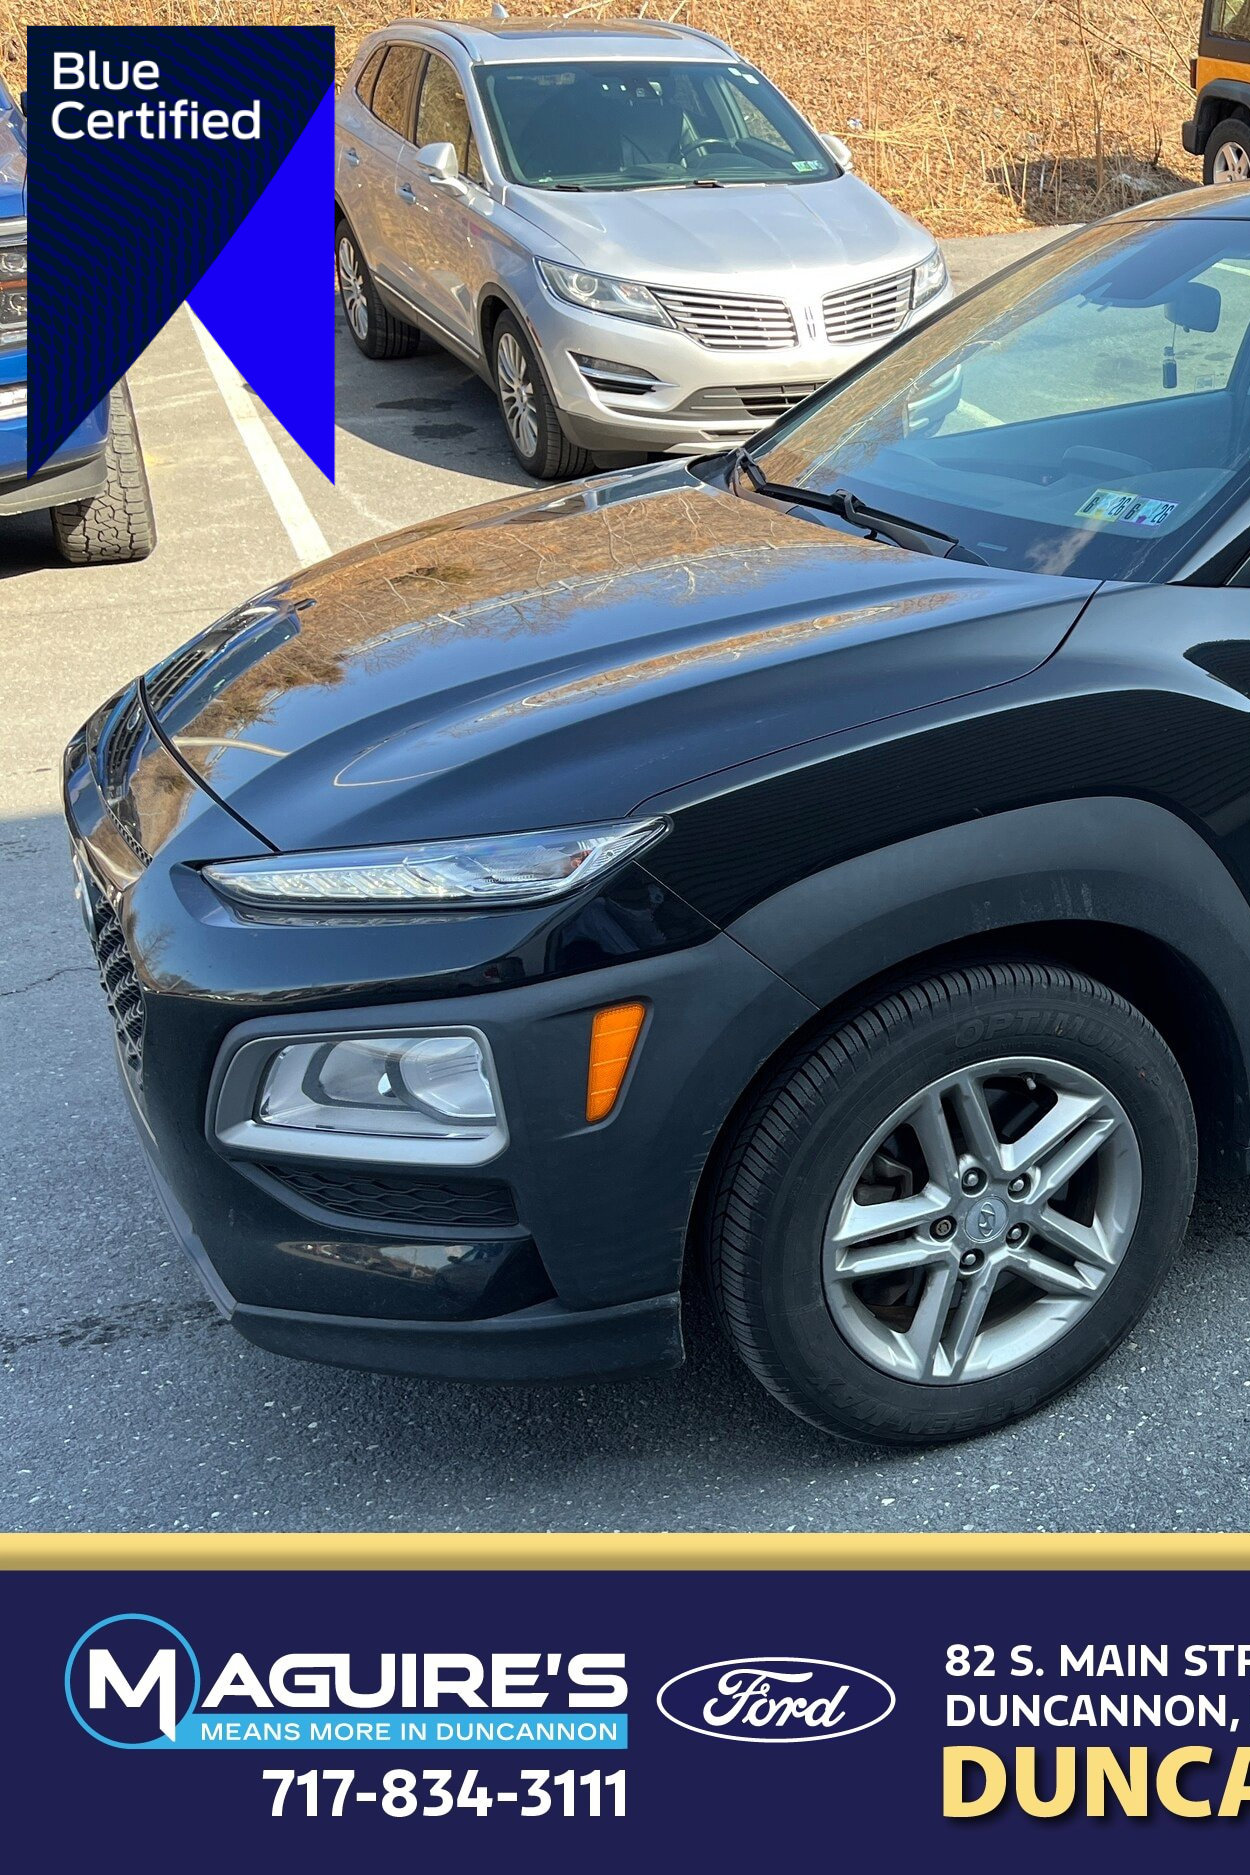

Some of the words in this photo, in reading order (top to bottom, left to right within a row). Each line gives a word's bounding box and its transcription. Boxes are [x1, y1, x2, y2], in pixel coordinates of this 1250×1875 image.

[1083, 497, 1099, 512] 6
[1108, 497, 1131, 515] 26
[1124, 504, 1141, 519] 6
[1151, 505, 1173, 523] 26
